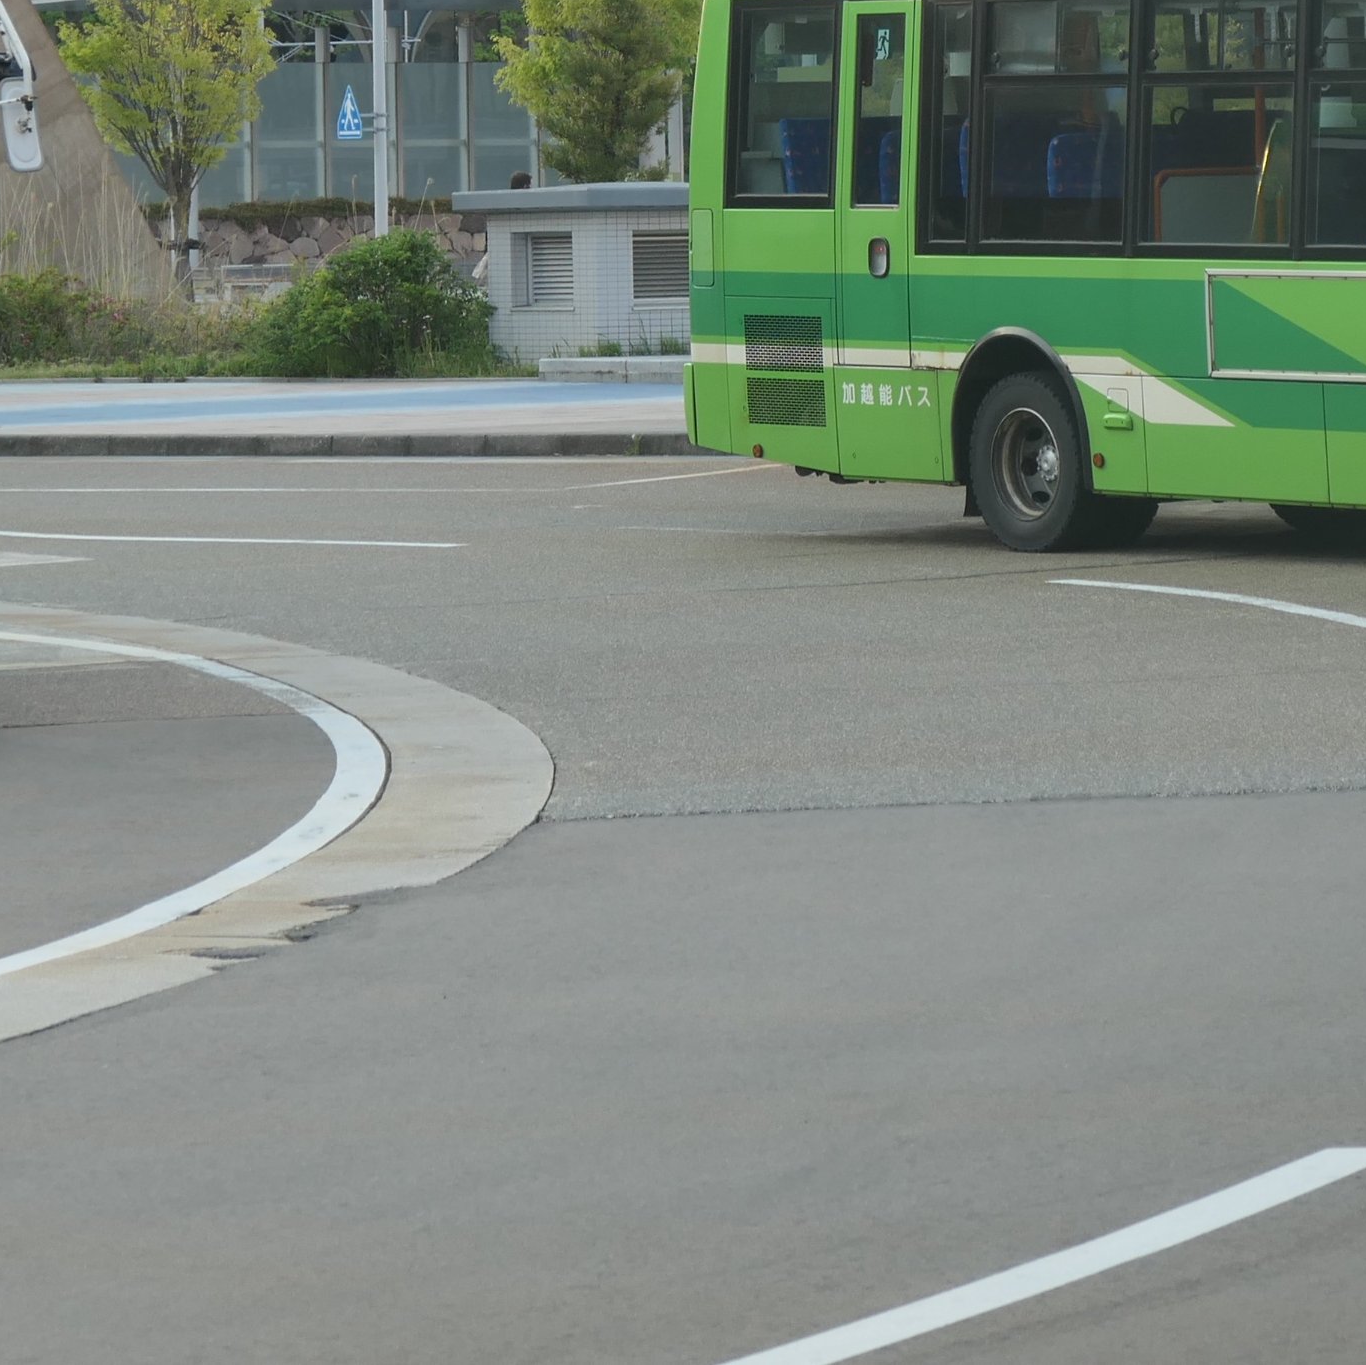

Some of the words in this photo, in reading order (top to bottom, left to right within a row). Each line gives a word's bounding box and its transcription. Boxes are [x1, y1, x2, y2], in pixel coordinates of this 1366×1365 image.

[842, 382, 931, 407] 加越能バス
